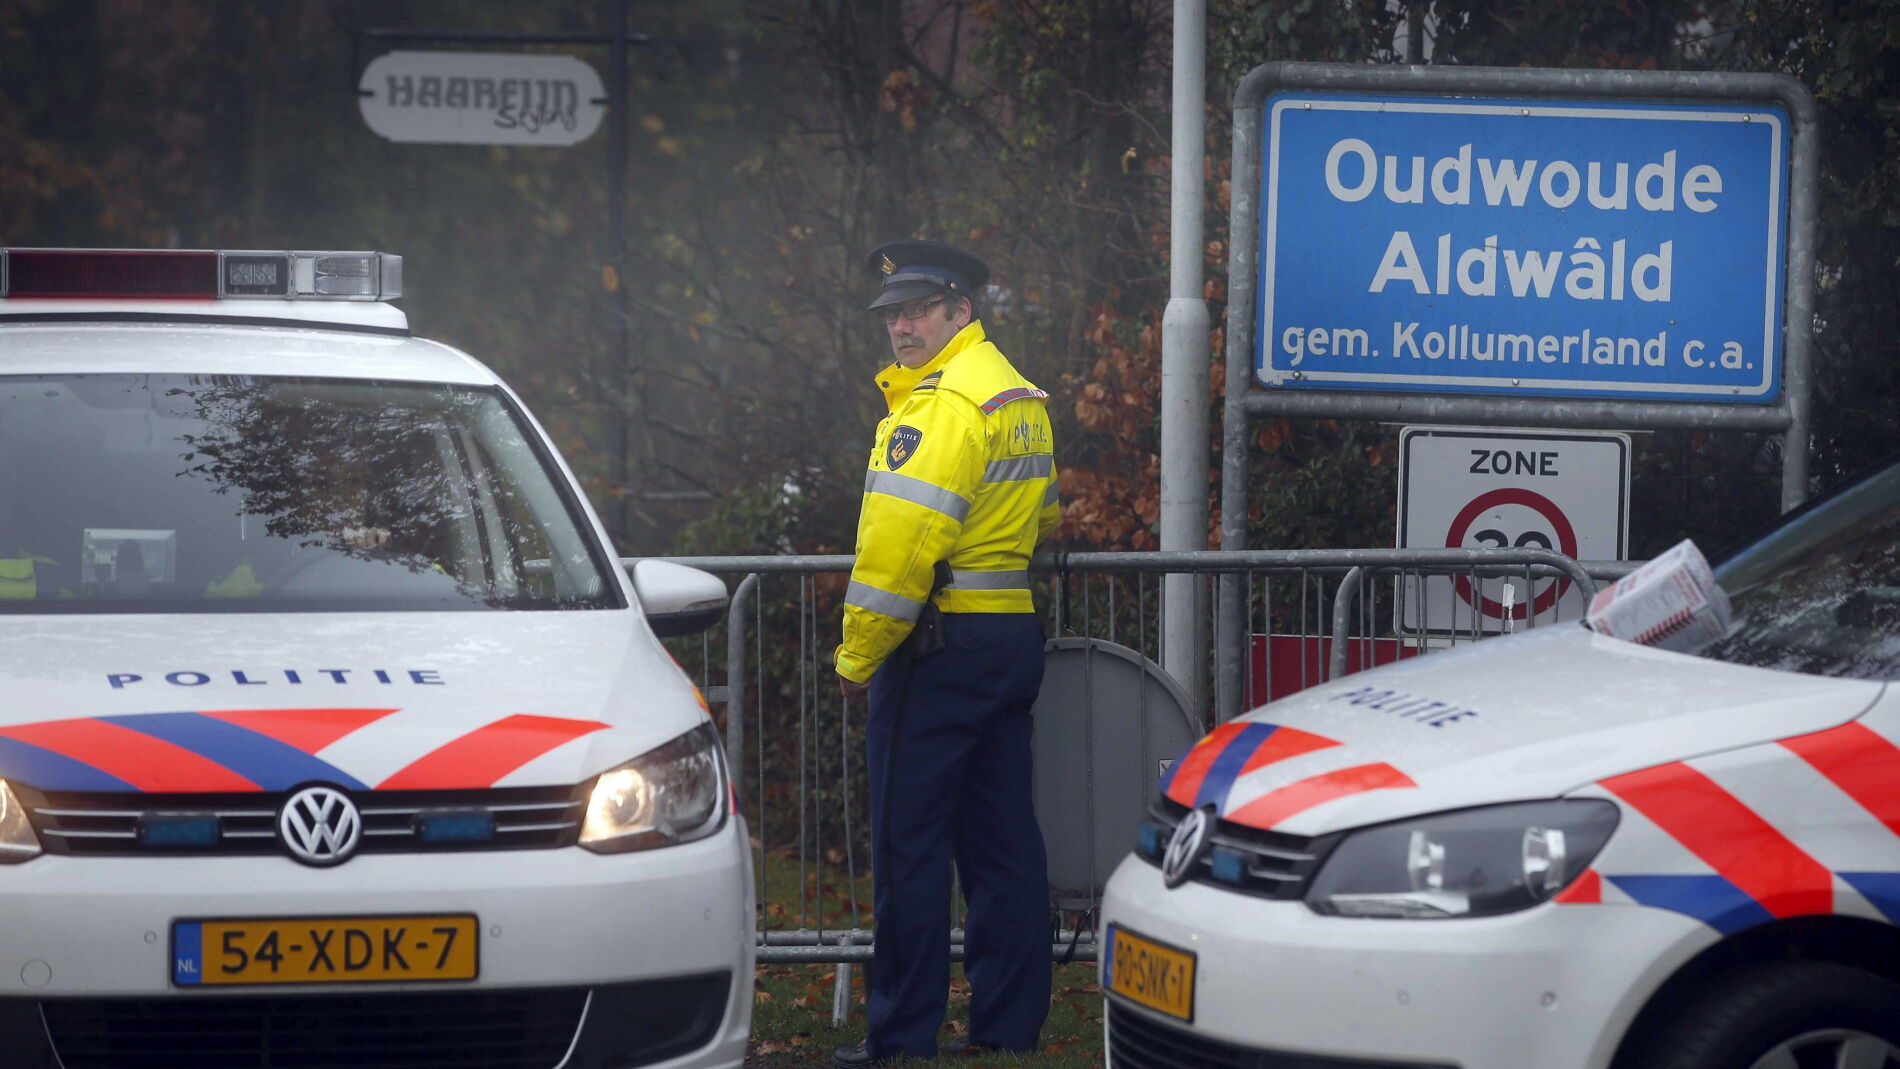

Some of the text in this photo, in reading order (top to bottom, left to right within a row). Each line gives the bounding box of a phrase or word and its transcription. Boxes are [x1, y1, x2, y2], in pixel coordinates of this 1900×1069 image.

[1324, 137, 1723, 213] Oudwoude
[1368, 230, 1673, 302] Aldwâld
[1282, 321, 1753, 370] gem. Kollumerland c.a.
[1470, 449, 1559, 477] ZONE
[106, 669, 445, 689] POLITIE
[1328, 687, 1478, 727] POLITIE
[284, 788, 357, 859] VW
[178, 959, 198, 973] NL
[221, 927, 458, 974] 54-XDK-7
